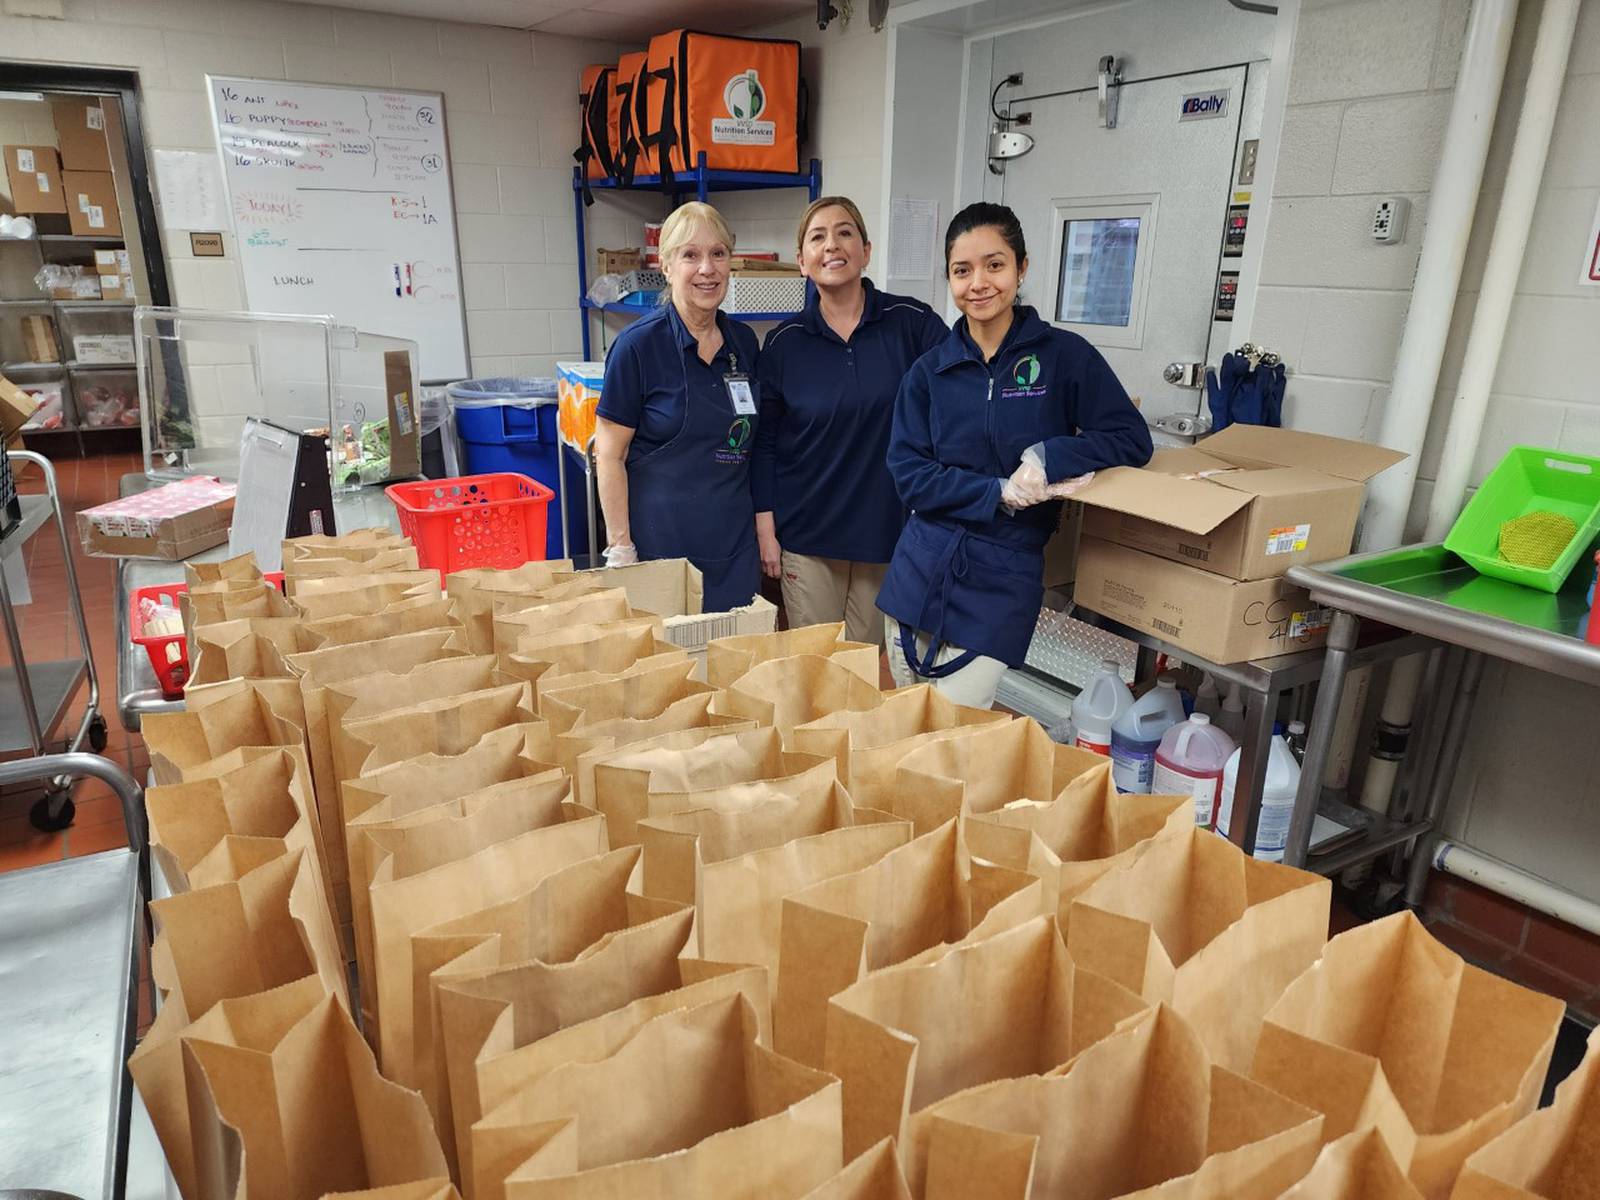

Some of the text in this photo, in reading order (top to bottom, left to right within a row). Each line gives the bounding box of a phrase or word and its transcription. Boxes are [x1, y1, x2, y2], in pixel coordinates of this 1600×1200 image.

[221, 87, 239, 101] 16
[1193, 95, 1224, 113] Bally
[249, 113, 286, 126] PUPPY
[714, 126, 773, 136] Nutrition Services
[235, 155, 251, 166] 16
[273, 275, 314, 285] LUNCH
